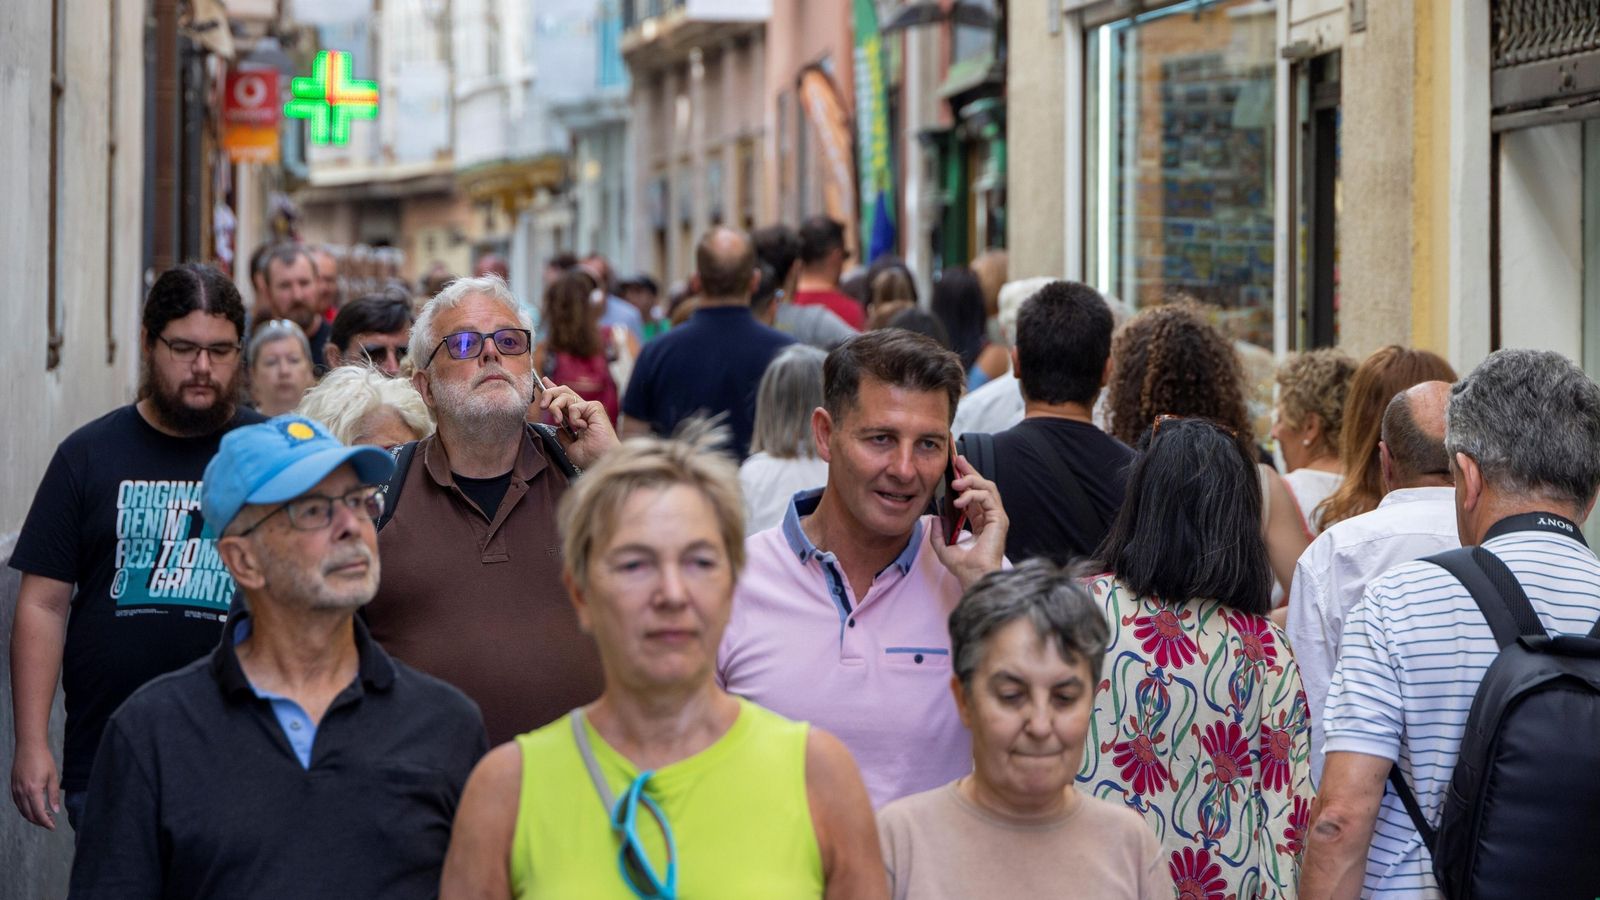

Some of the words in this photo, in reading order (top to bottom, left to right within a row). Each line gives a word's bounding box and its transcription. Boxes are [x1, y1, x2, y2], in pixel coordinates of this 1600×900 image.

[117, 480, 203, 510] ORIGINA
[116, 508, 188, 540] DENIM
[1537, 517, 1574, 533] SONY
[149, 567, 235, 604] GRMNTS
